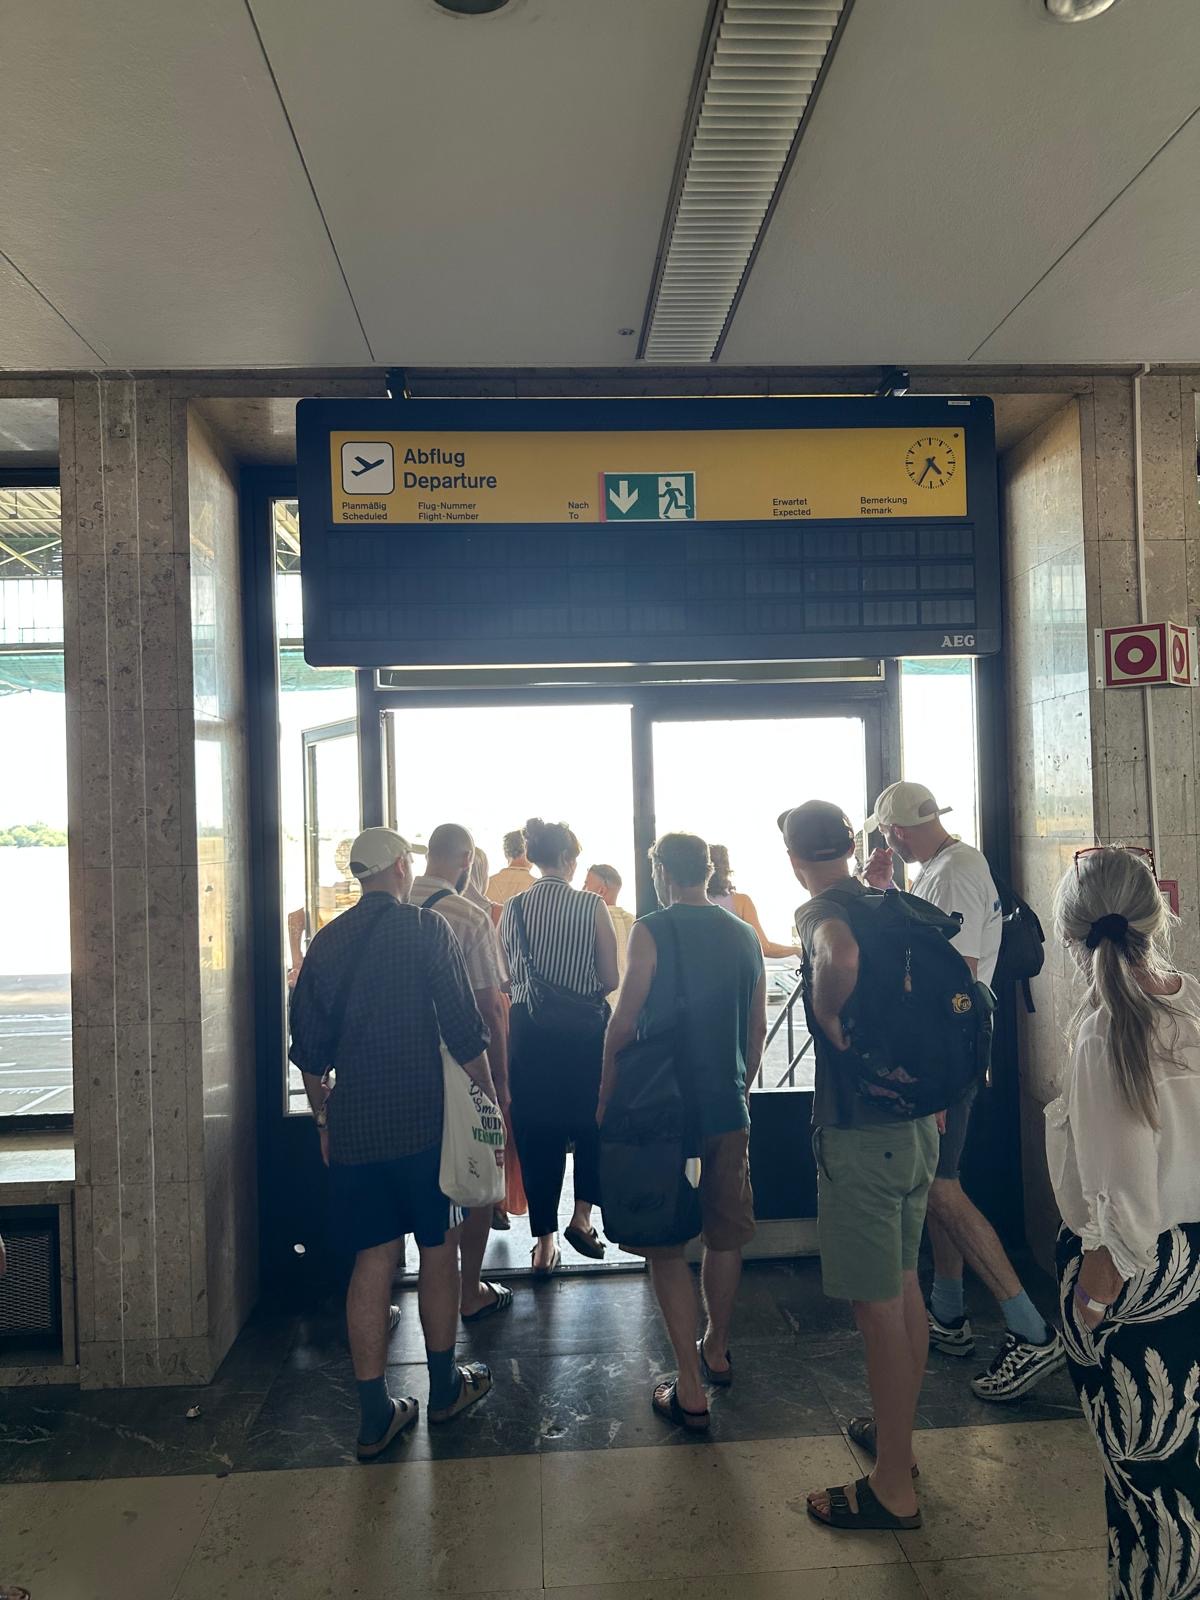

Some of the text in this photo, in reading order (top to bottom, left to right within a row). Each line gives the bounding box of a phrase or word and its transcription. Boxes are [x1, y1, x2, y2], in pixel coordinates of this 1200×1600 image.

[403, 448, 465, 467] Abflug
[403, 472, 497, 492] Departure
[568, 501, 590, 510] Nach
[773, 497, 808, 506] Erwartet
[860, 495, 908, 506] Bemerkung
[342, 501, 387, 511] Planmäßig
[418, 501, 477, 511] Flug-Nummer
[860, 505, 893, 515] Remark
[342, 511, 388, 521] Scheduled
[418, 511, 479, 521] Flight-Number
[568, 511, 579, 520] To
[773, 507, 811, 517] Expected
[941, 634, 976, 648] AEG
